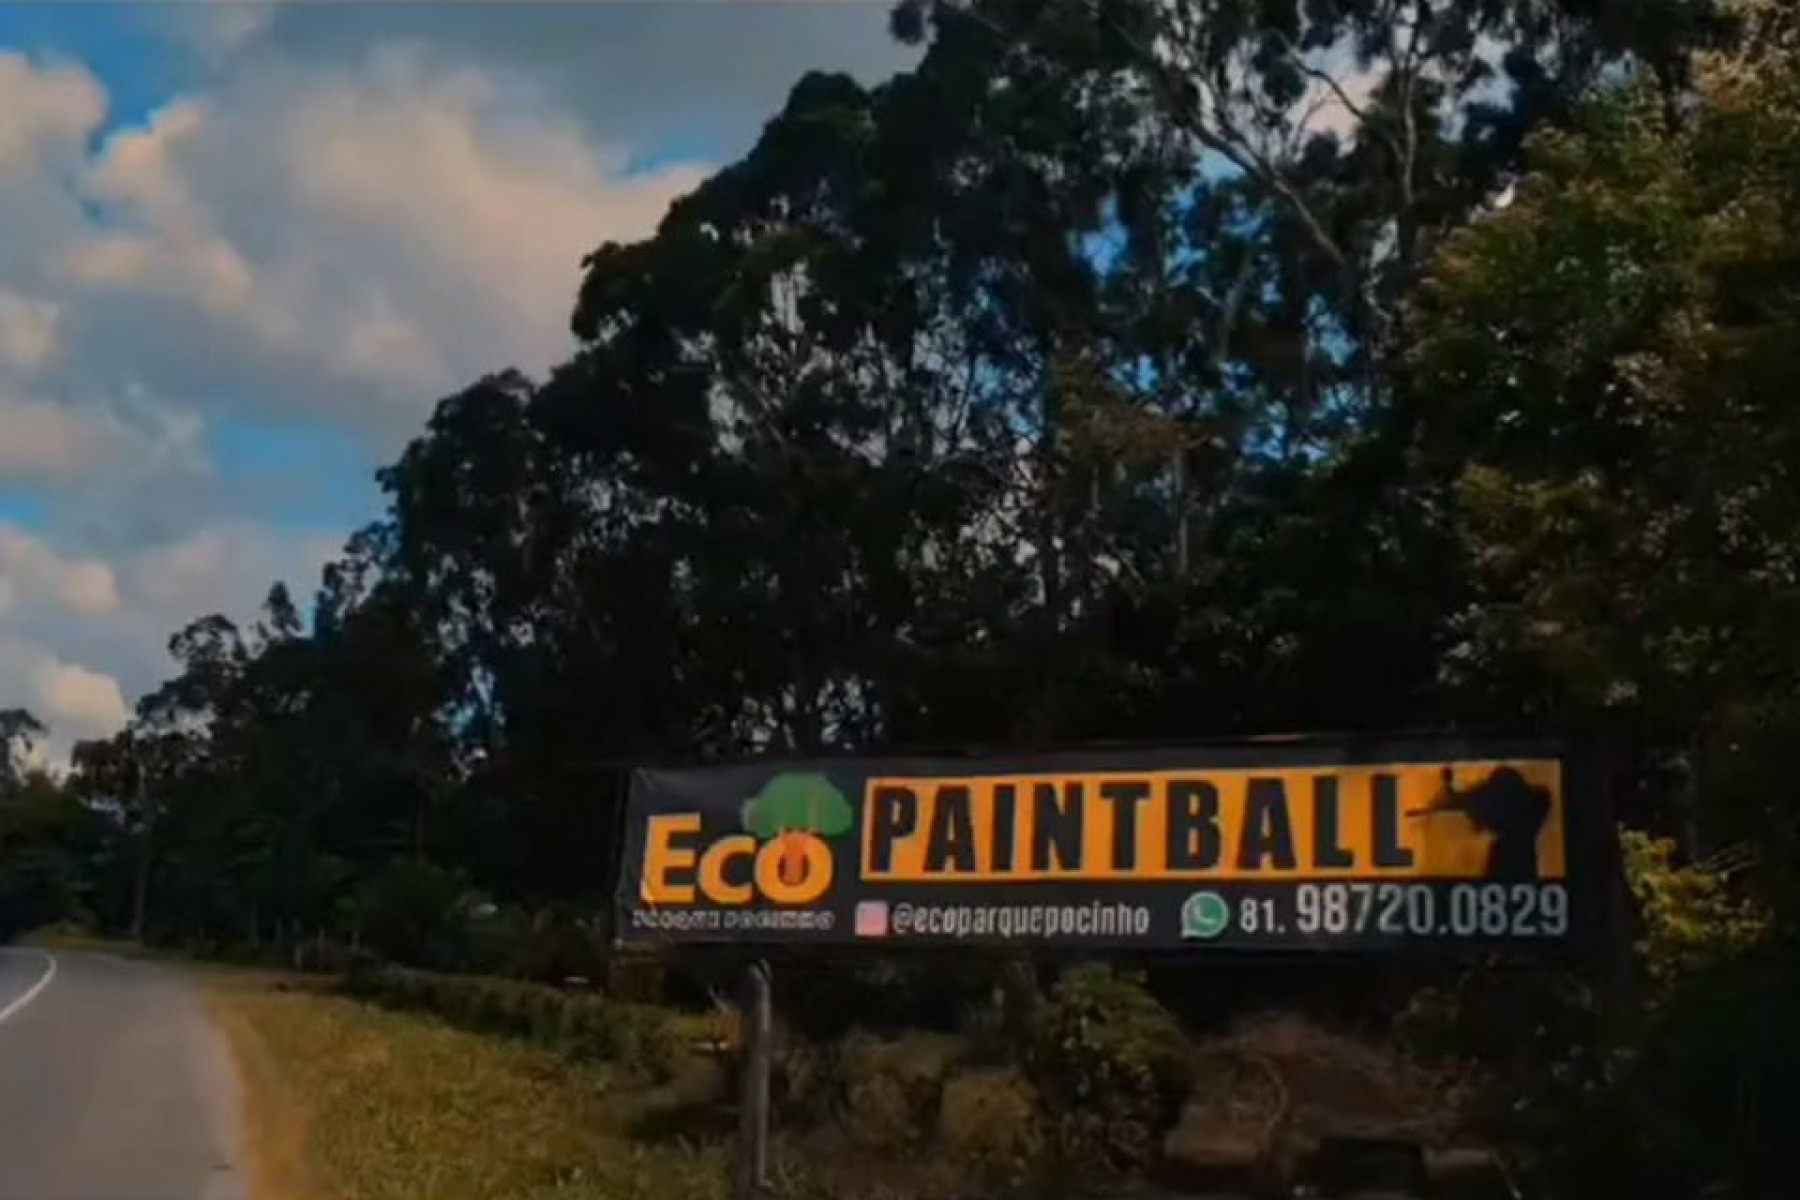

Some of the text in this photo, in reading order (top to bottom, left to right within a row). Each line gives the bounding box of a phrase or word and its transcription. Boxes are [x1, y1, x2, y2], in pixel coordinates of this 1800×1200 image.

[868, 775, 1413, 872] PAINTBALL
[892, 901, 1150, 937] @ecoparquepocinho
[1240, 884, 1567, 935] 81. 98720.0829
